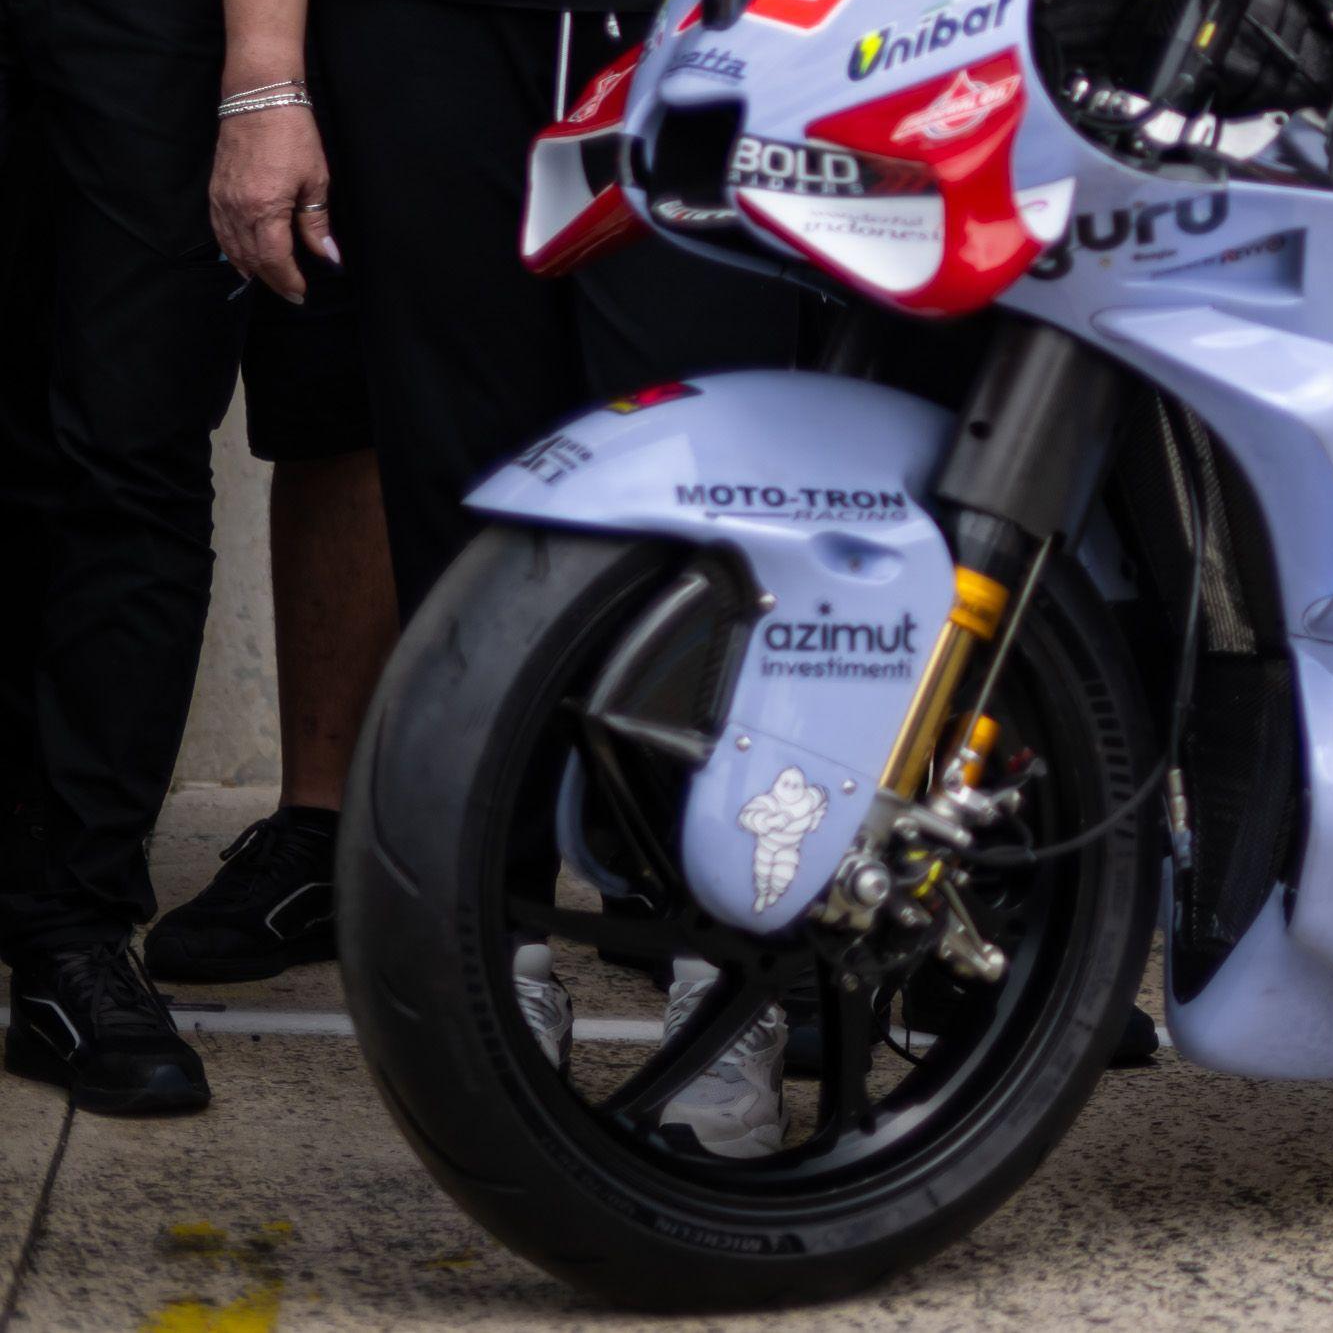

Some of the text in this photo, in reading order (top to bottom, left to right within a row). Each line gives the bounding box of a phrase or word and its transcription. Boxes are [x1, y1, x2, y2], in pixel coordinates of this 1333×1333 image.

[732, 137, 860, 184] BOLD
[675, 484, 906, 508] MOTO-TRON
[764, 603, 918, 654] azimut
[761, 655, 912, 678] investimenti
